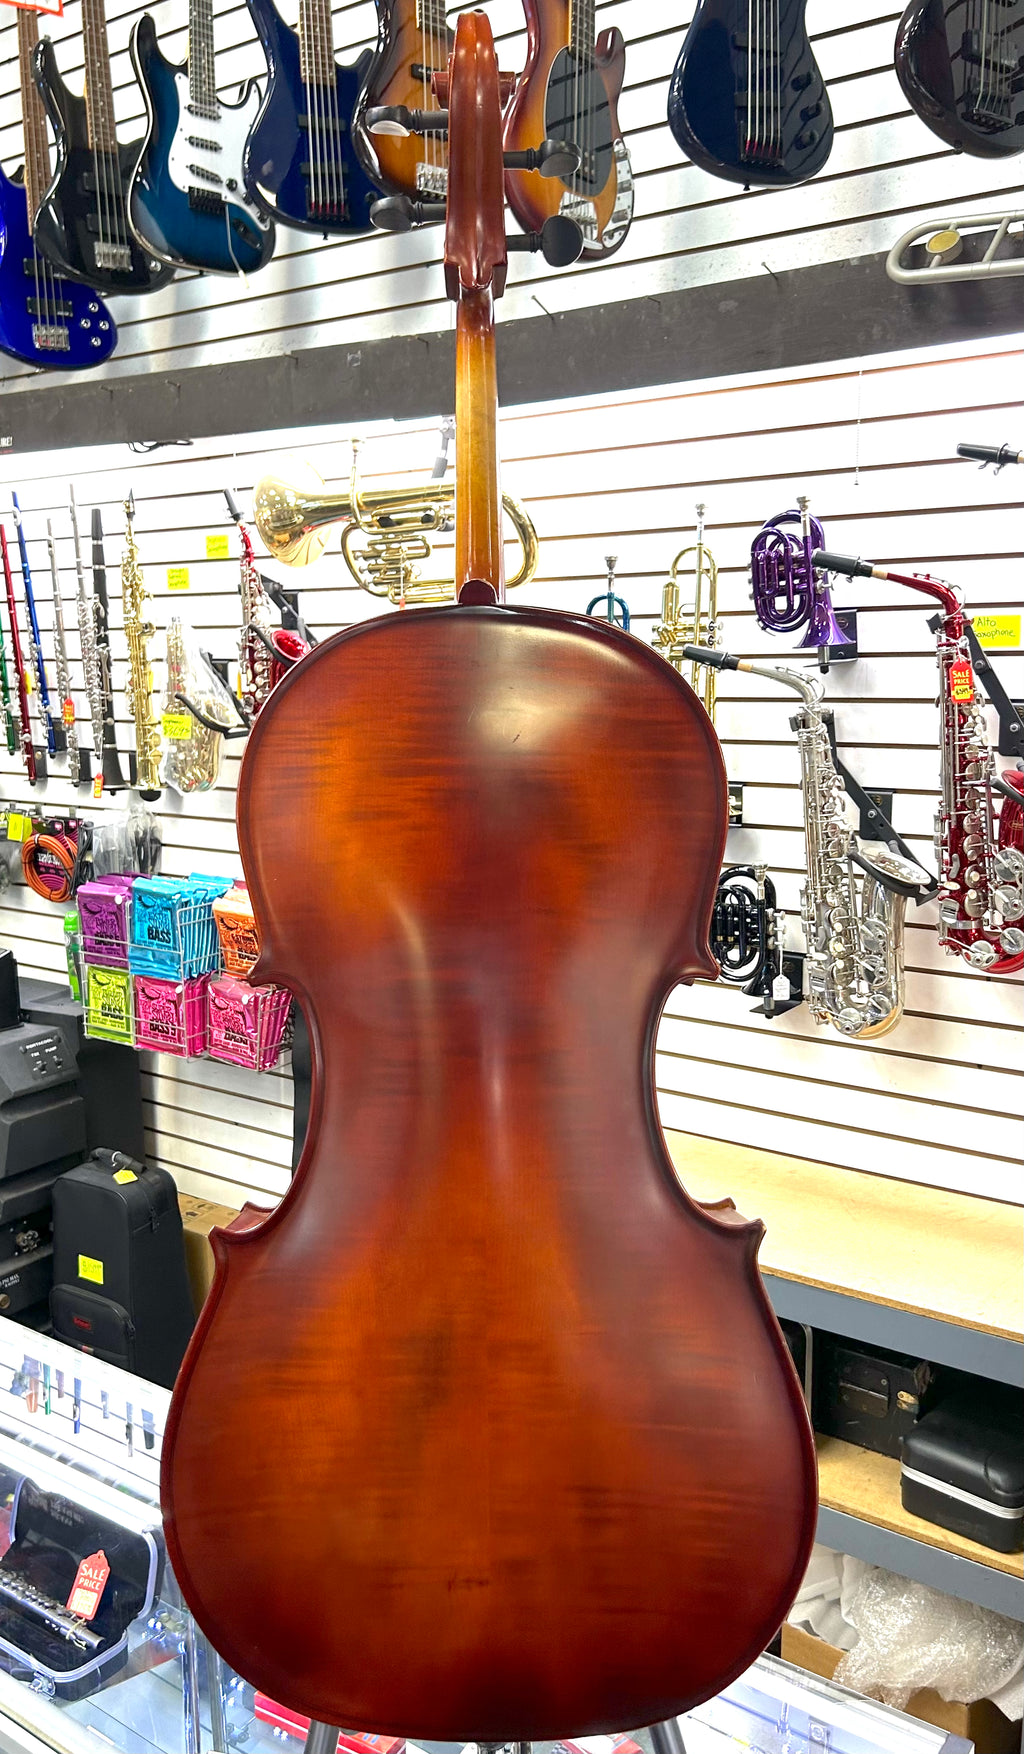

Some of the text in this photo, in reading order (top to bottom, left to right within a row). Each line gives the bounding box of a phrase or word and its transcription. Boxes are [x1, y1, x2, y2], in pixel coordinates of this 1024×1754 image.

[976, 616, 997, 627] Alto
[952, 669, 970, 679] SALE
[147, 926, 172, 944] BASS
[80, 1563, 106, 1581] SALE
[78, 1577, 101, 1590] PRICE
